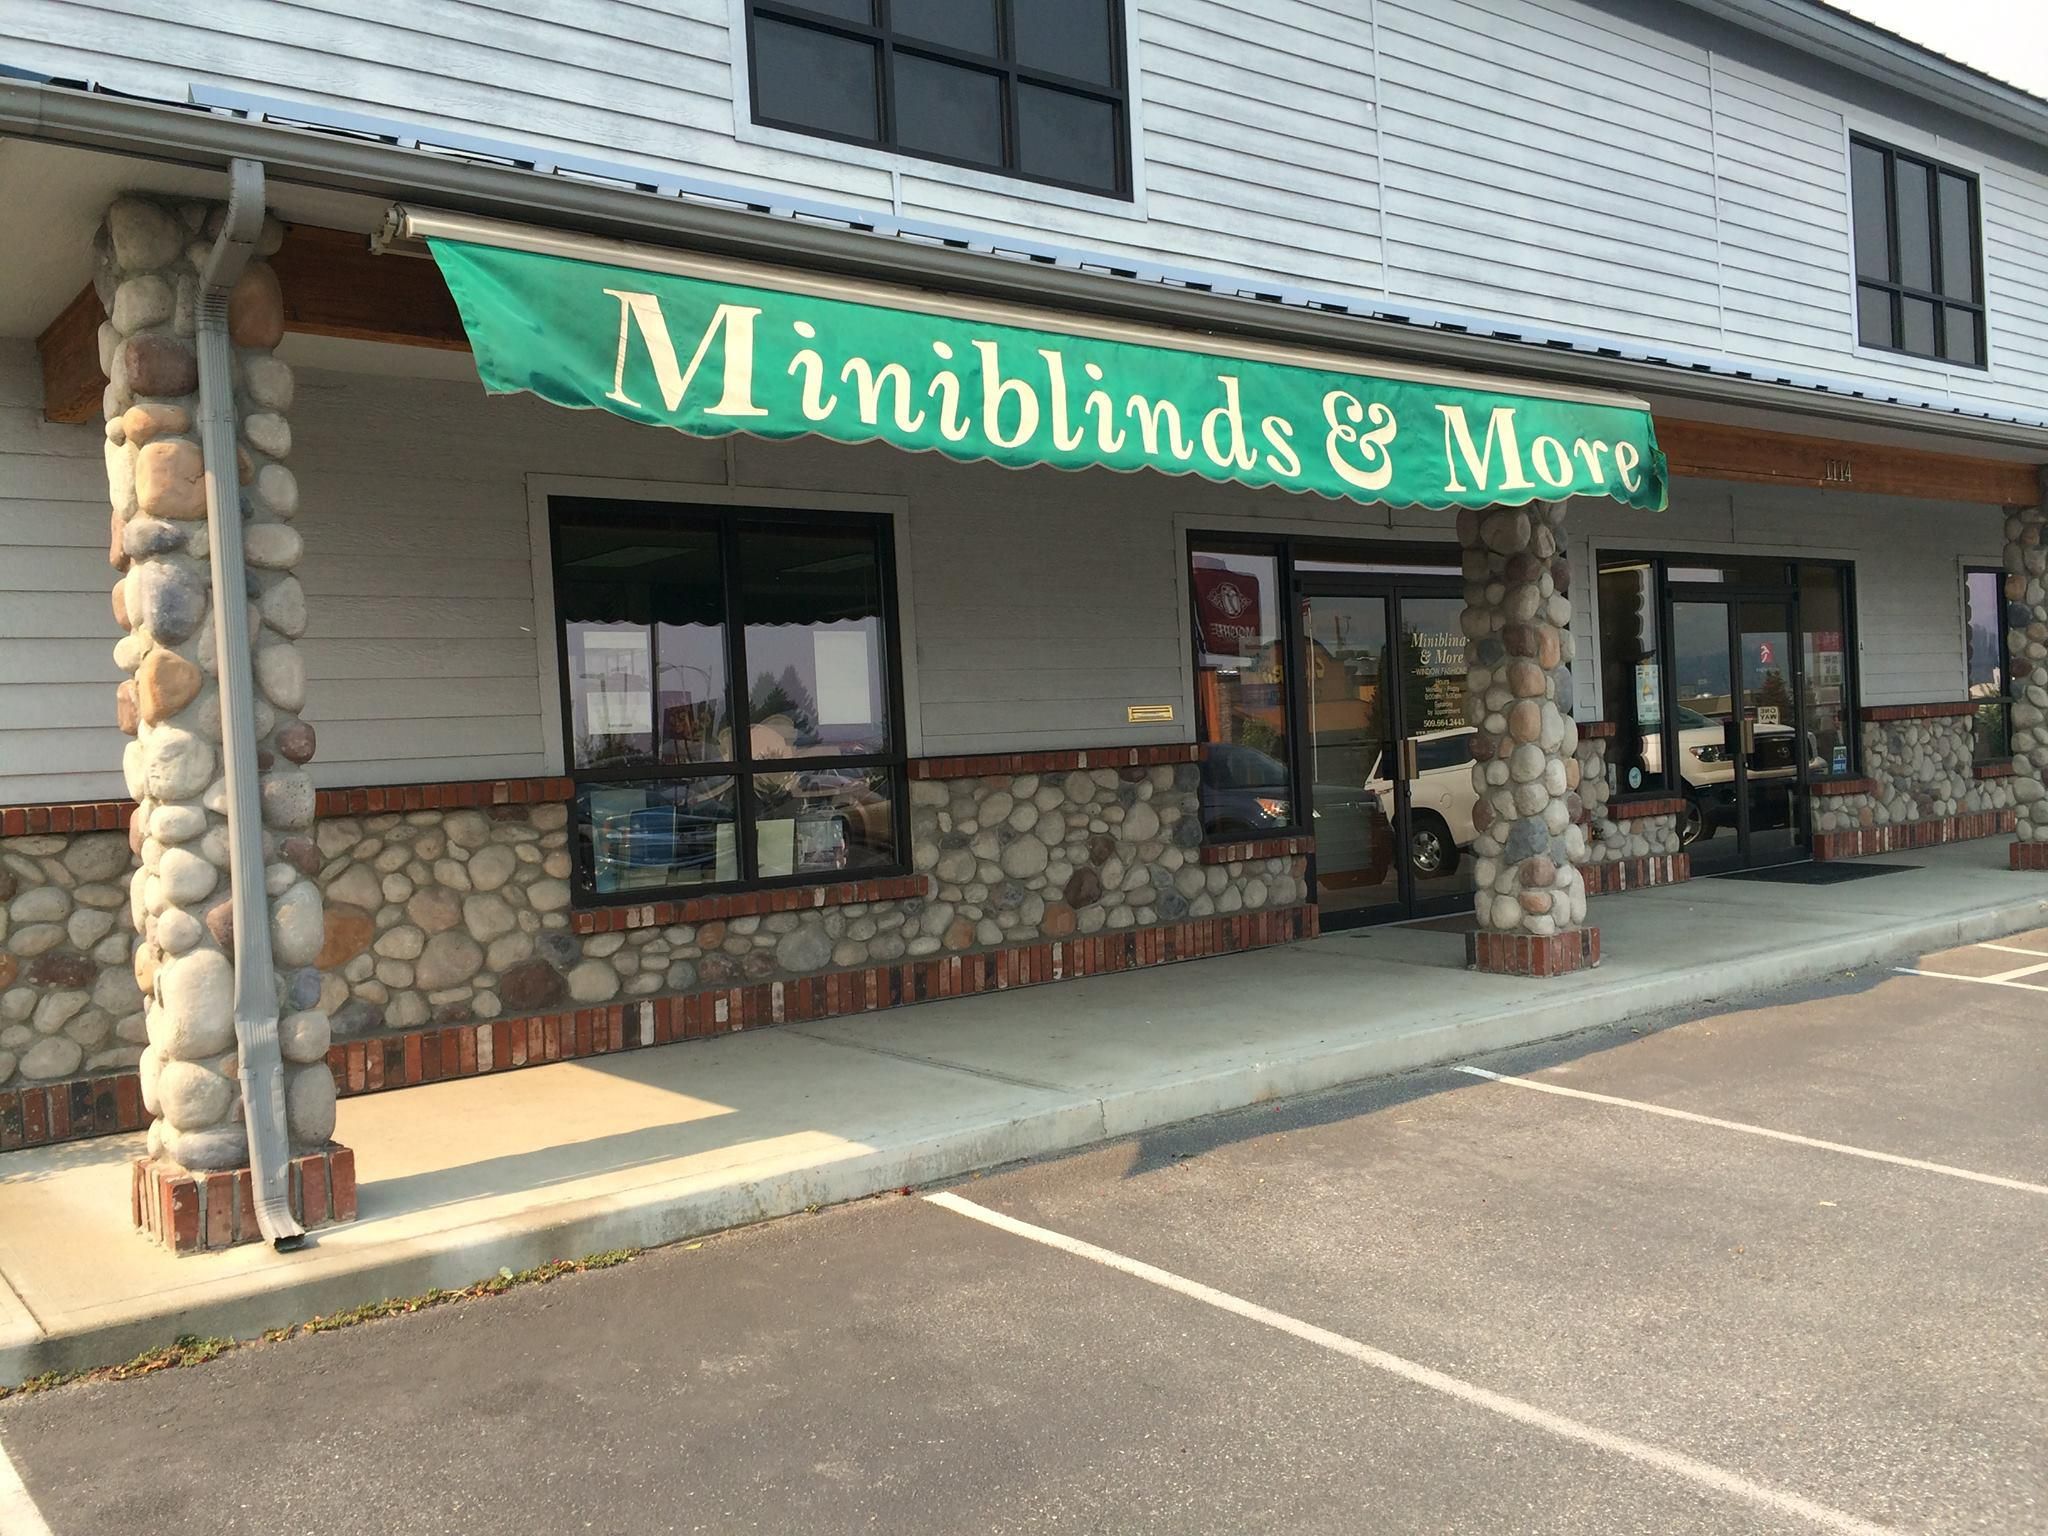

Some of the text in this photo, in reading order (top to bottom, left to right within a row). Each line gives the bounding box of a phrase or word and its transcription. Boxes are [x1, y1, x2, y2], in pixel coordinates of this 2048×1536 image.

[602, 288, 1641, 492] Miniblinds & More
[1411, 632, 1470, 648] Miniblind
[1420, 649, 1464, 665] & More
